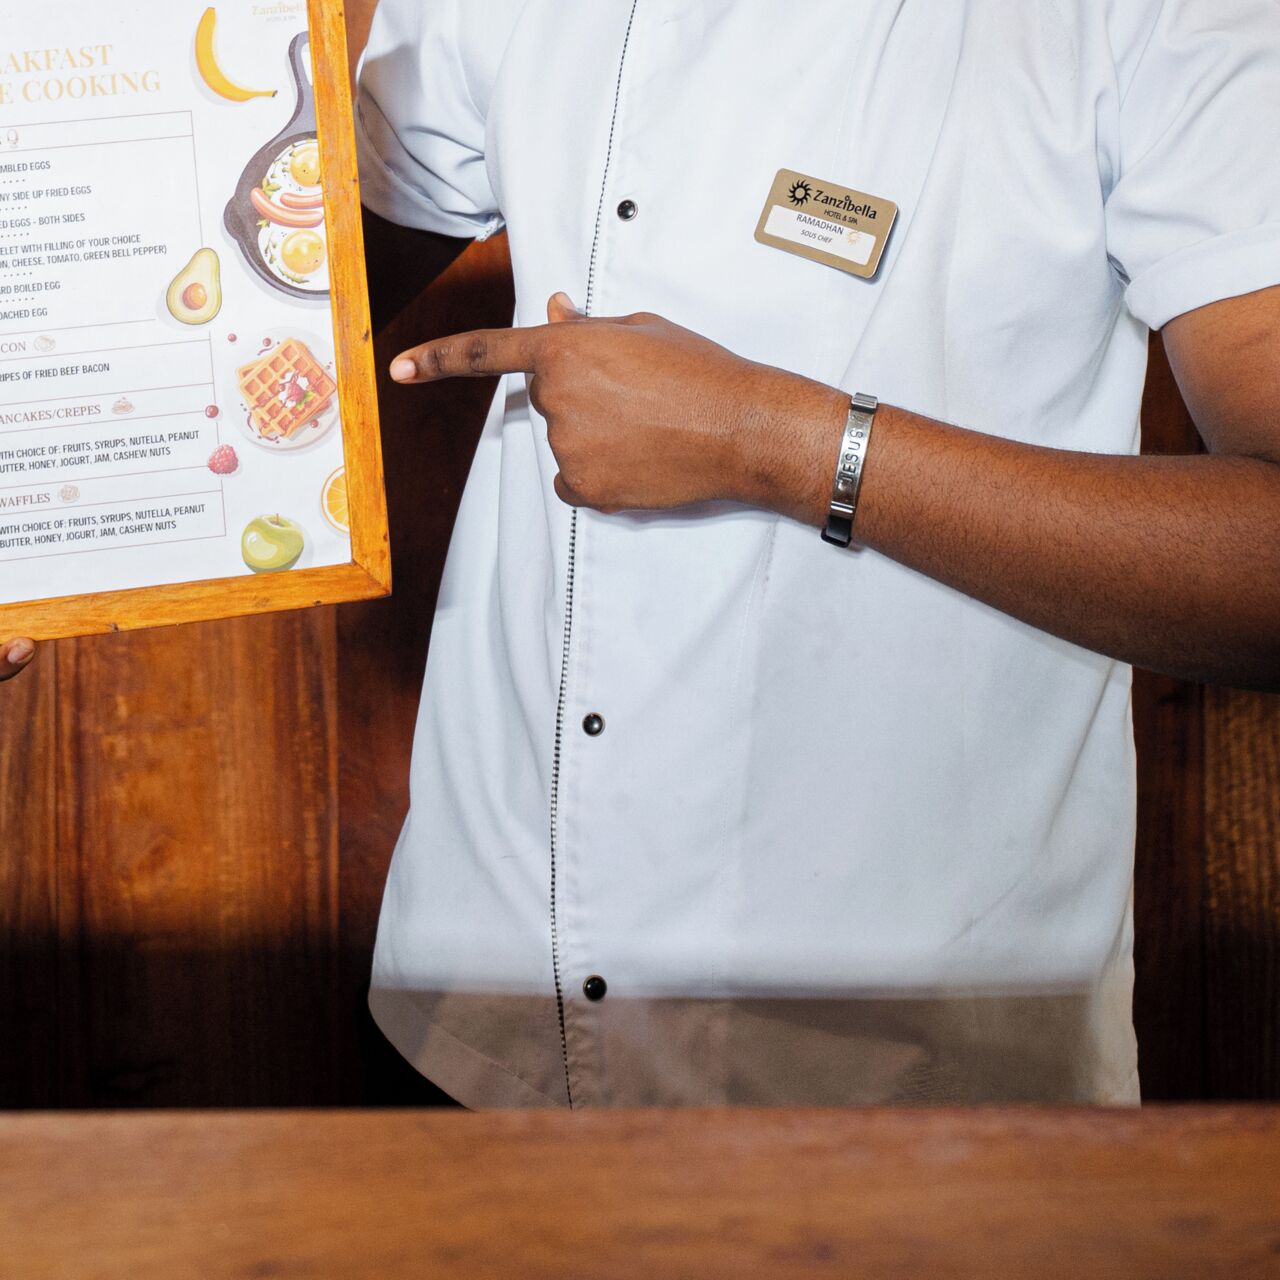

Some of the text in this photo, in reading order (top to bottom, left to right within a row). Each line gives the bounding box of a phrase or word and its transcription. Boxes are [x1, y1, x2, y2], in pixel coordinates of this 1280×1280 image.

[22, 71, 161, 102] COOKING
[30, 161, 50, 170] EGGS
[12, 191, 30, 200] SIDE
[32, 190, 43, 198] UP
[45, 188, 68, 198] FRIED
[71, 186, 92, 196] EGGS
[813, 189, 877, 220] Zanzibella
[10, 218, 31, 228] EGGS
[38, 216, 60, 225] BOTH
[62, 213, 85, 223] SIDES
[797, 214, 844, 235] RAMADHAN
[824, 209, 842, 220] HOTEL
[848, 216, 858, 225] SPA
[21, 244, 43, 253] WITH
[44, 240, 75, 252] FILLING
[76, 239, 86, 248] OF
[88, 237, 110, 247] YOUR
[112, 234, 141, 245] CHOICE
[800, 229, 832, 244] SOUS CHEF
[12, 256, 45, 268] CHEESE,
[47, 253, 82, 264] TOMATO,
[84, 251, 110, 261] GREEN
[112, 248, 130, 258] BELL
[133, 245, 167, 255] PEPPER)
[14, 283, 43, 293] BOILED
[45, 281, 61, 290] EGG
[32, 308, 48, 316] EGG
[22, 371, 32, 380] OF
[35, 369, 58, 378] FRIED
[60, 366, 79, 376] BEEF
[82, 363, 110, 373] BACON
[16, 447, 46, 458] CHOICE
[49, 446, 60, 455] OF:
[63, 442, 92, 454] FRUITS,
[95, 439, 127, 450] SYRUPS,
[130, 435, 166, 446] NUTELLA,
[168, 430, 200, 441] PEANUT
[29, 460, 58, 470] HONEY,
[60, 456, 91, 466] JOGURT,
[94, 454, 111, 463] JAM,
[113, 449, 147, 461] CASHEW
[149, 447, 170, 456] NUTS
[840, 429, 864, 484] JESUS
[0, 504, 205, 535] WITH CHOICE OF: FRUITS, SYRUPS, NUTELLA, PEANUT
[0, 521, 176, 548] BUTTER, HONEY, JOGURT, JAM, CASHEW NUTS
